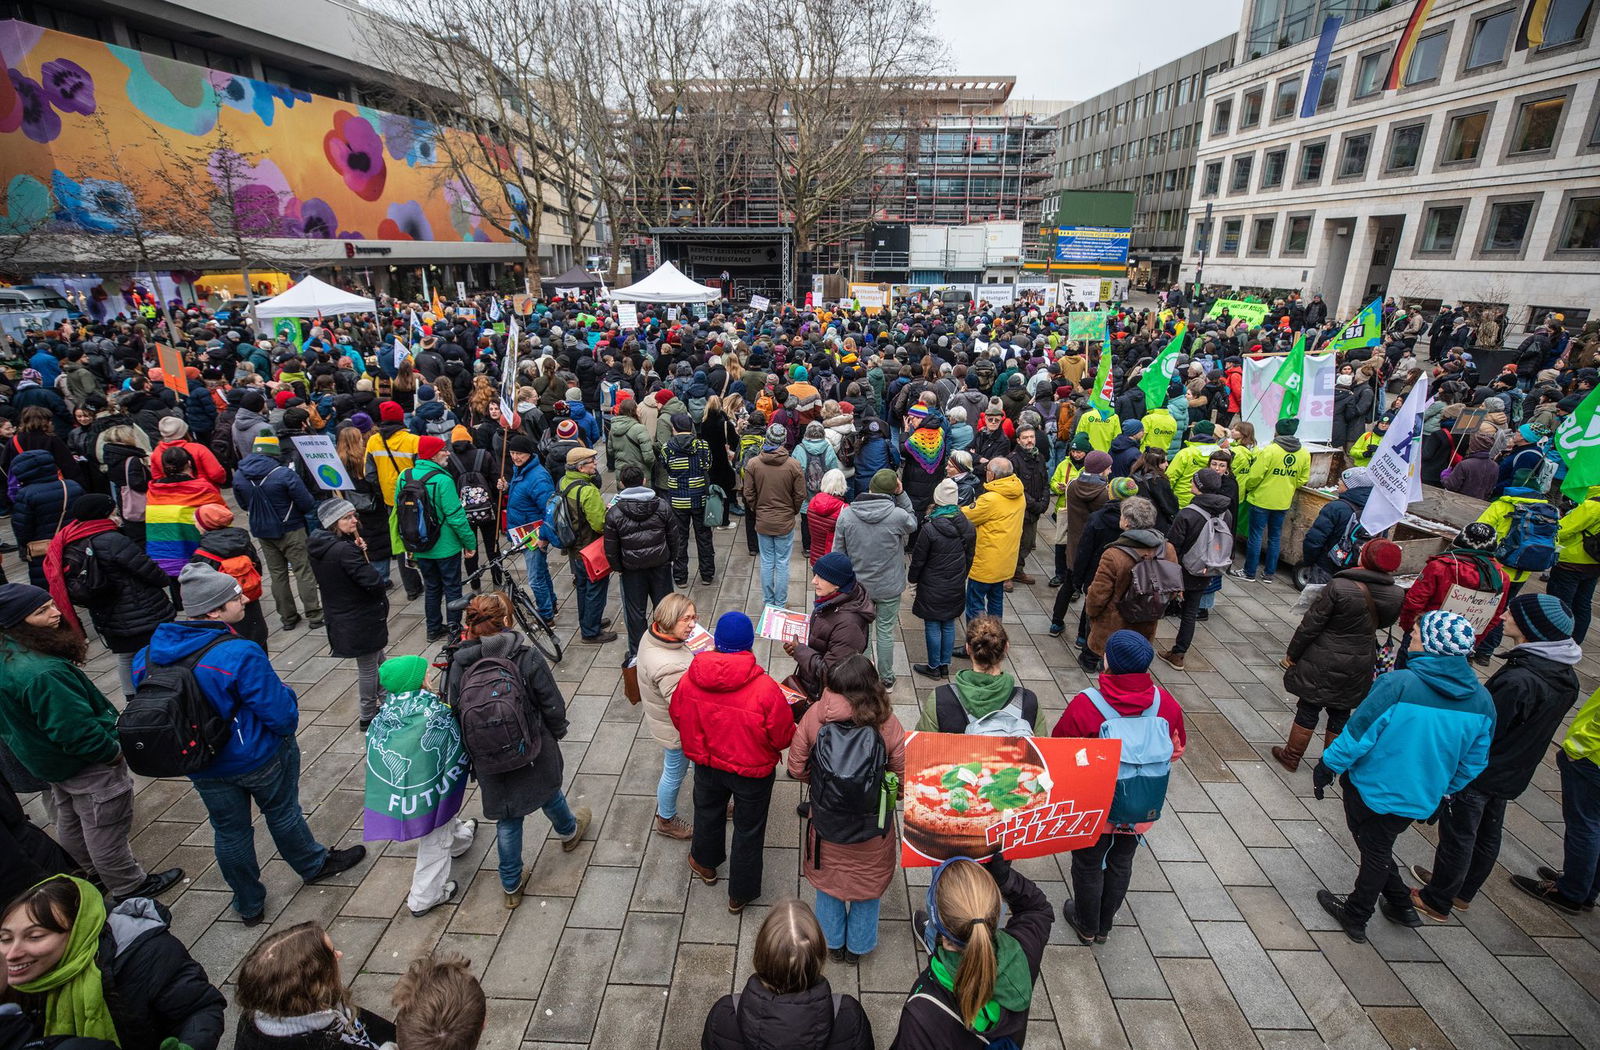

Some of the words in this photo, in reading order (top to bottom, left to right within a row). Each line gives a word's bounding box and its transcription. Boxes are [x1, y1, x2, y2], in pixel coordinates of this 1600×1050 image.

[388, 751, 470, 815] FUTURE
[985, 800, 1075, 847] PIZZA
[1001, 809, 1104, 852] PIZZA
